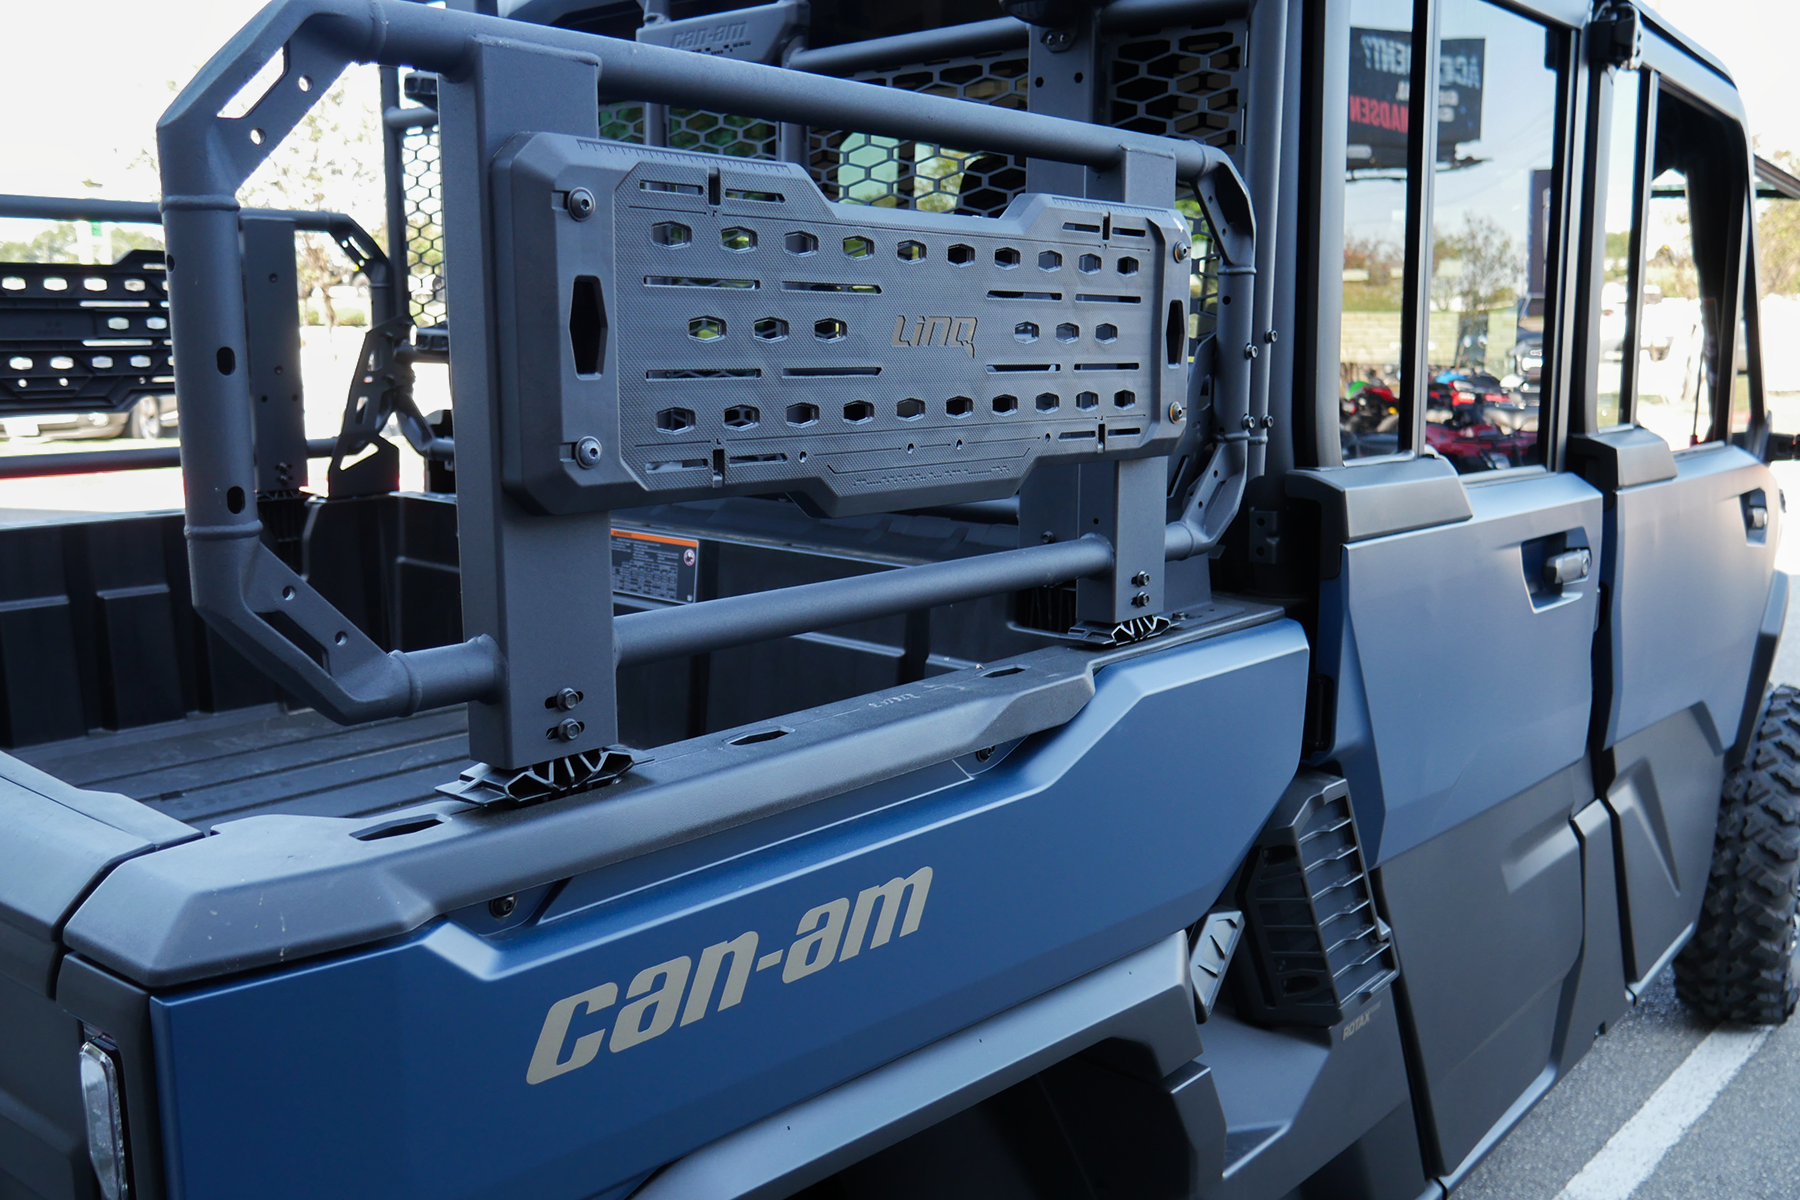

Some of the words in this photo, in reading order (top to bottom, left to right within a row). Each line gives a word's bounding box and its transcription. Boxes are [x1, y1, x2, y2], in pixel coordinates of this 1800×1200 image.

[670, 21, 748, 48] can-am
[526, 866, 934, 1085] can-am
[1342, 1010, 1371, 1041] ROTAX
